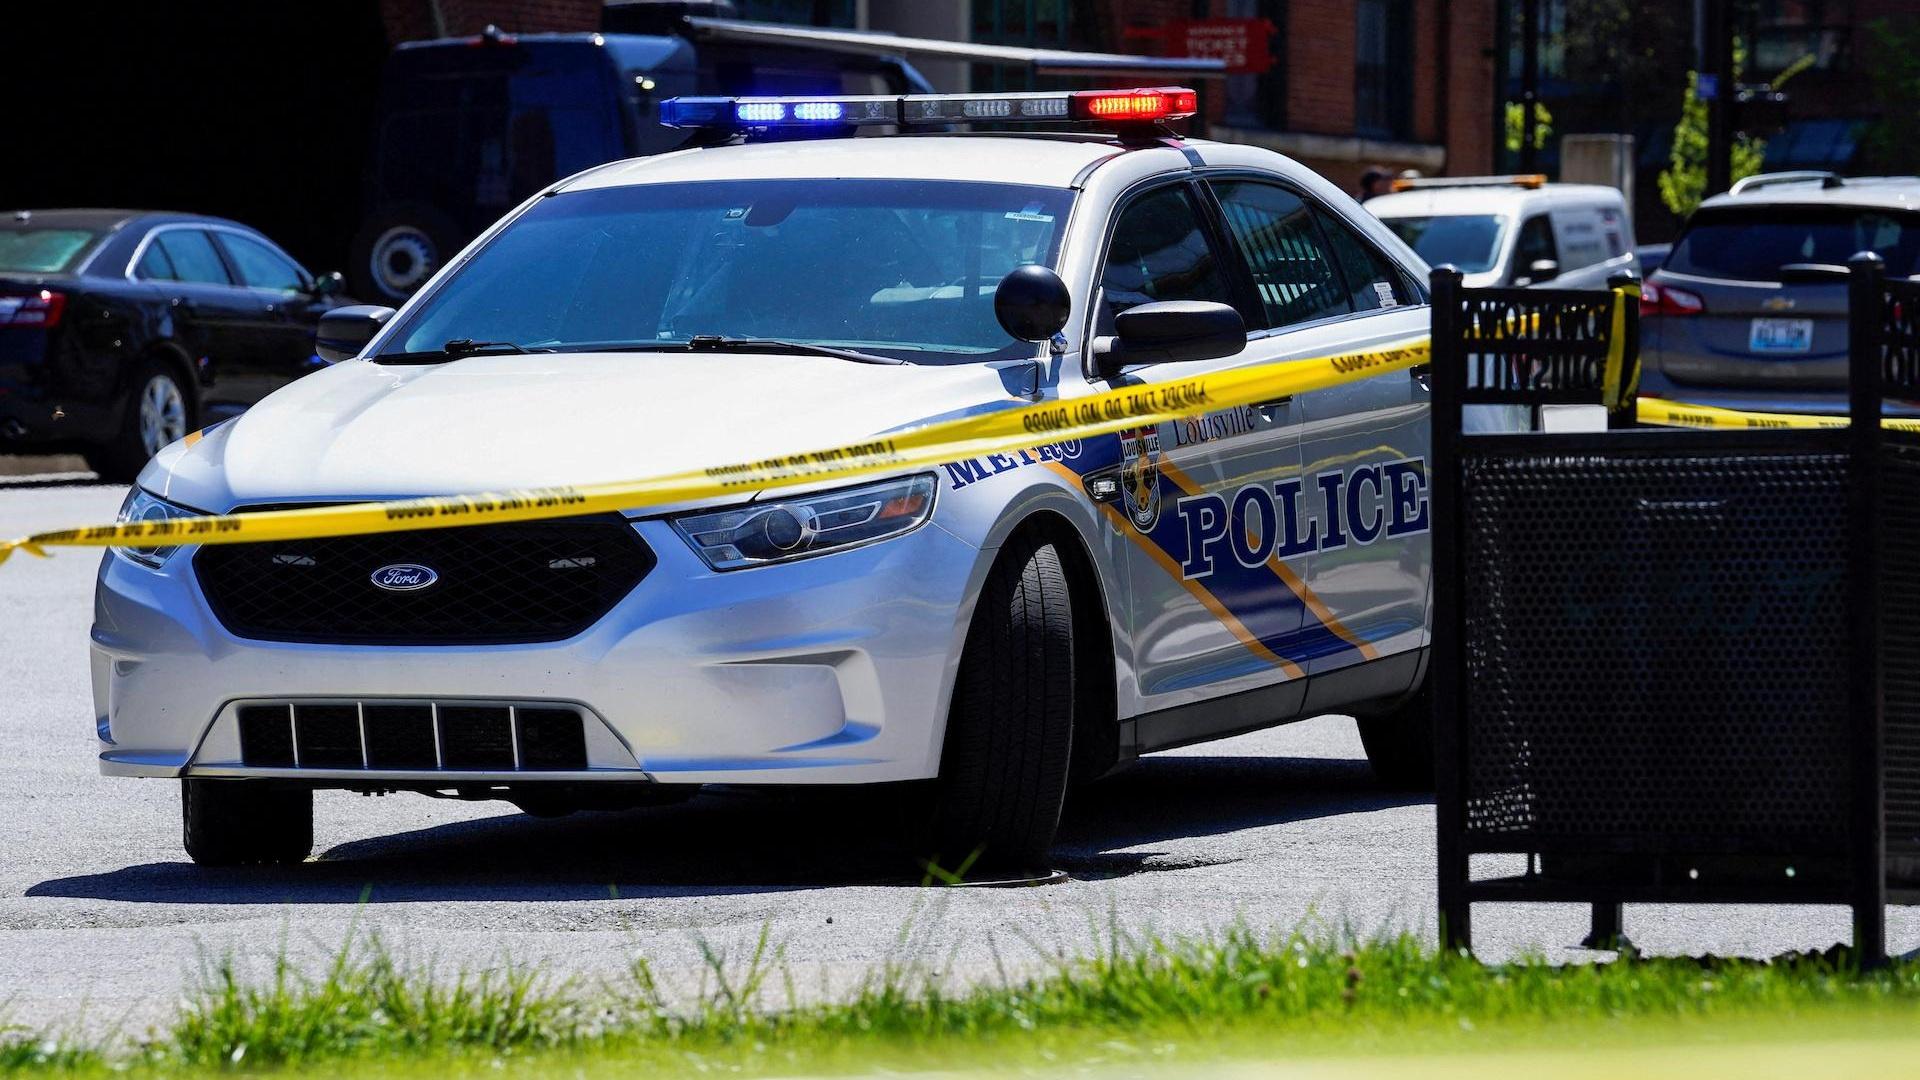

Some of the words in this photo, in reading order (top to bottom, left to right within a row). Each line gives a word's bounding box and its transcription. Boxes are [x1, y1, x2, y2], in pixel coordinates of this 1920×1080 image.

[1174, 405, 1254, 446] Louisville
[940, 438, 1082, 491] METRO
[1122, 436, 1160, 458] LOUISVILLE
[1177, 455, 1430, 580] POLICE
[384, 567, 421, 585] Ford
